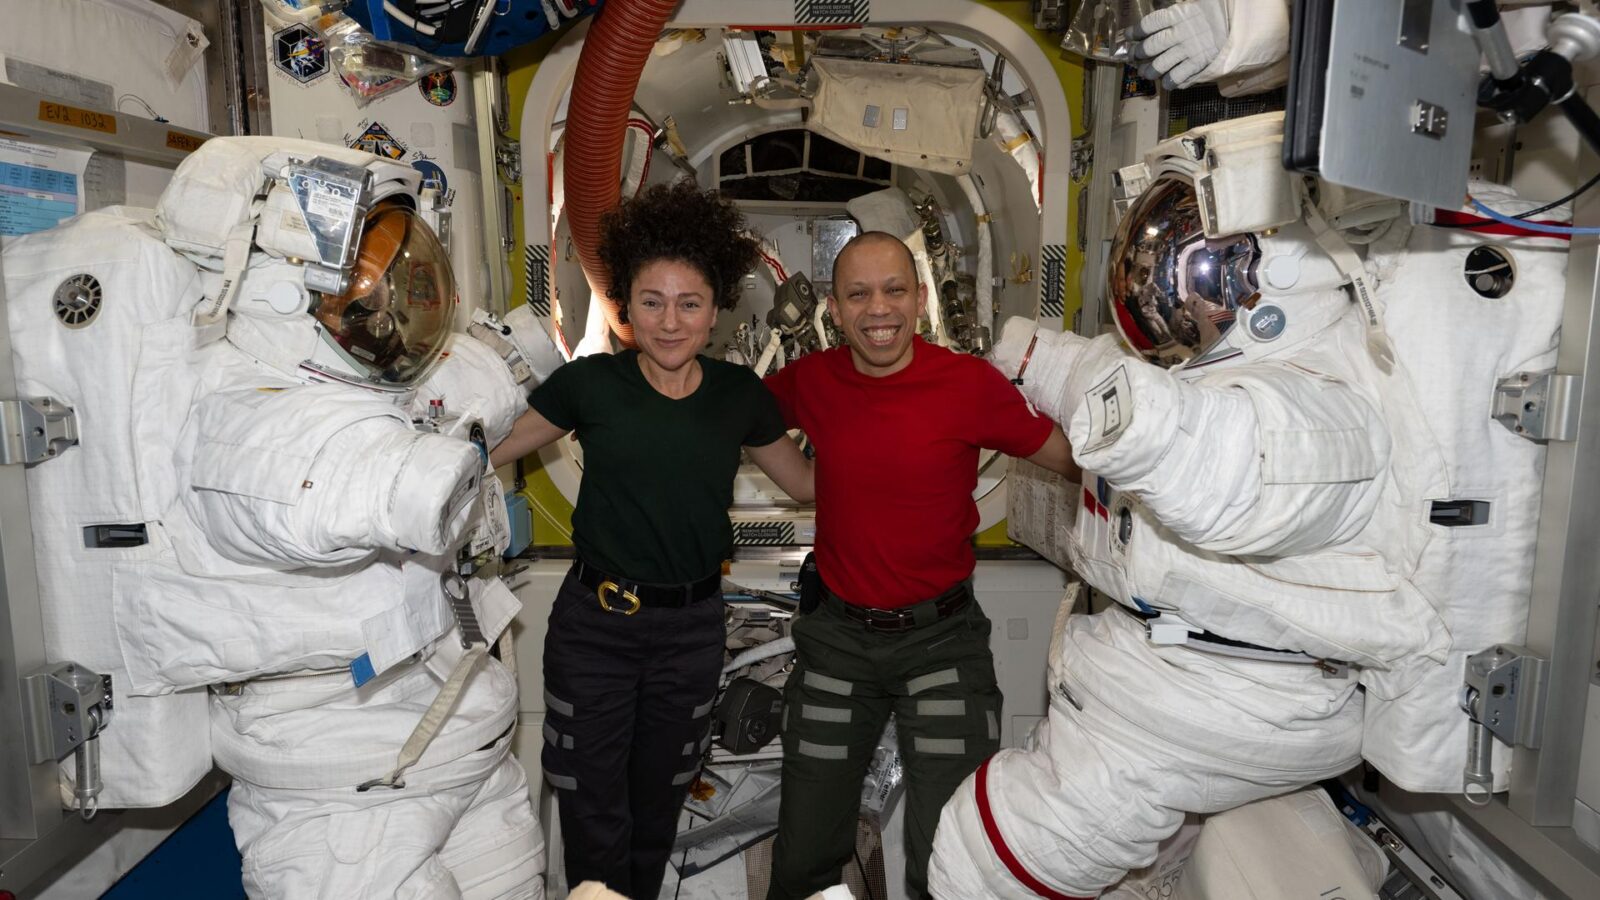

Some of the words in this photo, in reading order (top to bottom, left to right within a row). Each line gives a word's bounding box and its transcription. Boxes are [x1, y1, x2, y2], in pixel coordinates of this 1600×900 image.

[46, 105, 70, 121] EV2
[80, 111, 107, 129] 1032
[879, 780, 891, 802] Tether
